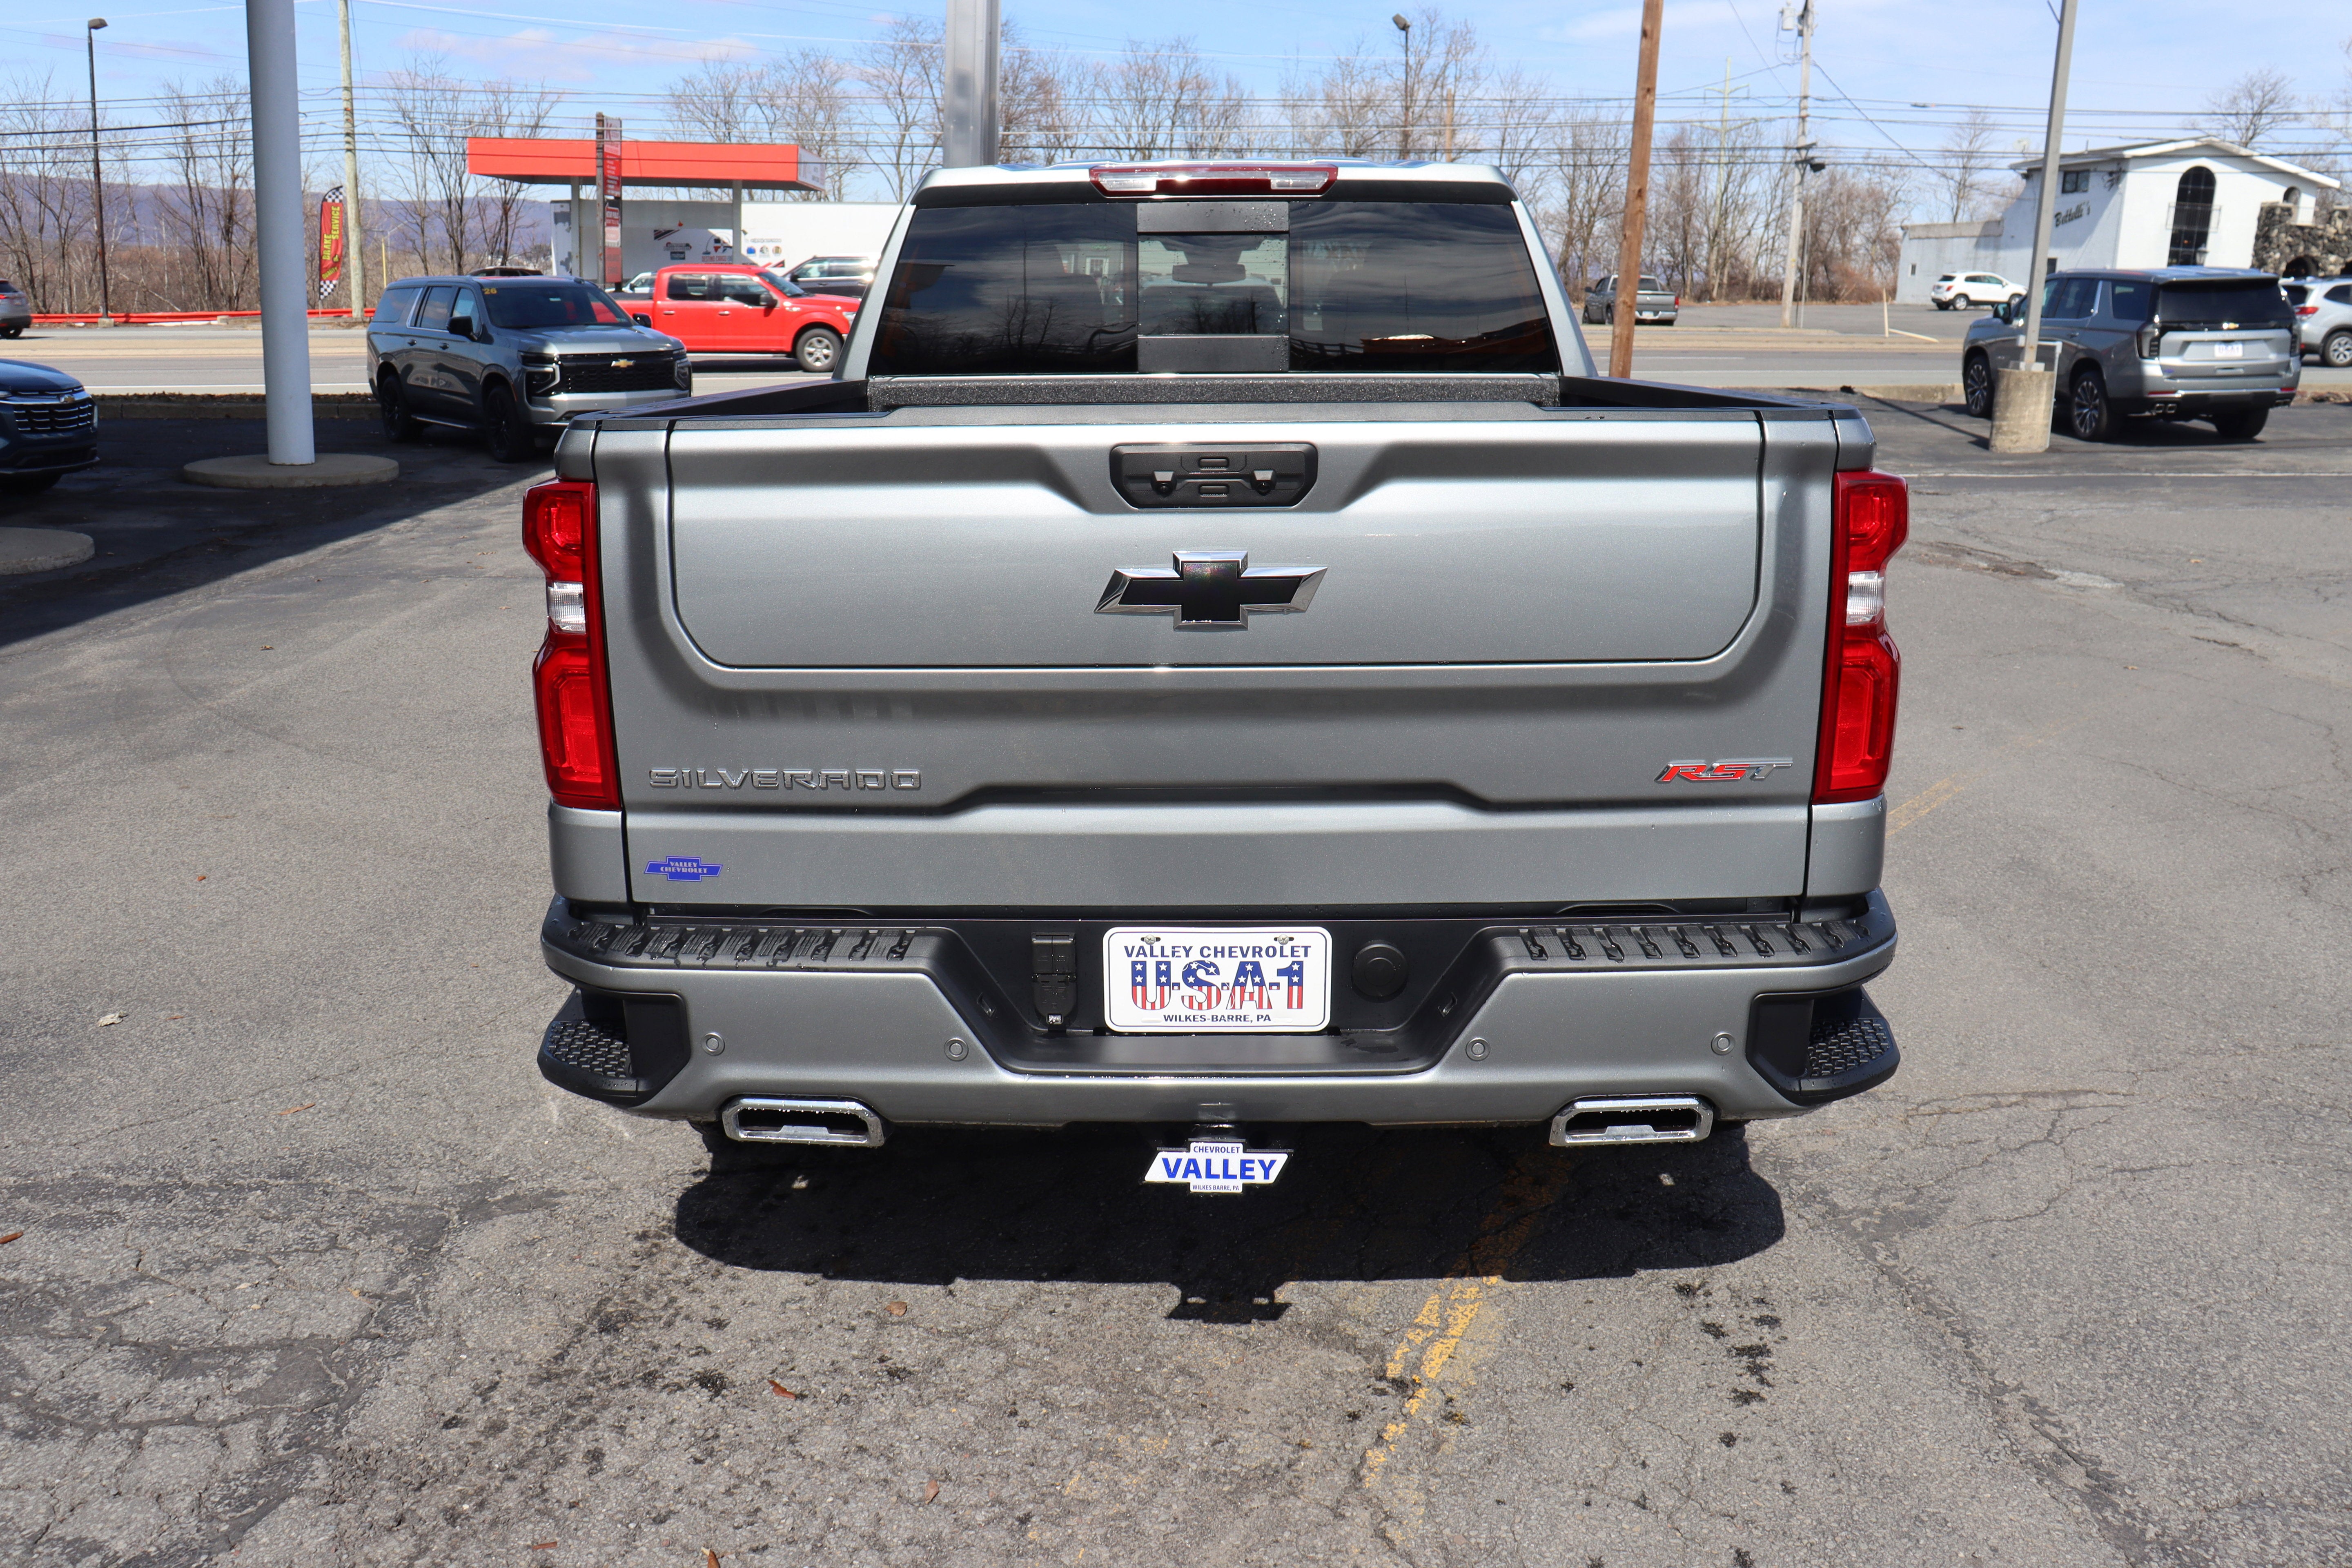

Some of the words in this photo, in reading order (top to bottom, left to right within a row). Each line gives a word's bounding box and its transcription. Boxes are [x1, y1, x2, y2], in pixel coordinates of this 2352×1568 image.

[331, 206, 340, 240] SERVICE
[322, 234, 332, 261] BRAKE
[650, 768, 921, 789] SILVERADO
[1654, 760, 1793, 782] RST
[1124, 945, 1193, 958] VALLEY
[1199, 945, 1312, 958] CHEVROLET
[1163, 1014, 1253, 1023] WILKES-BARRE,
[1256, 1014, 1271, 1022] PA
[1162, 1158, 1277, 1180] VALLEY
